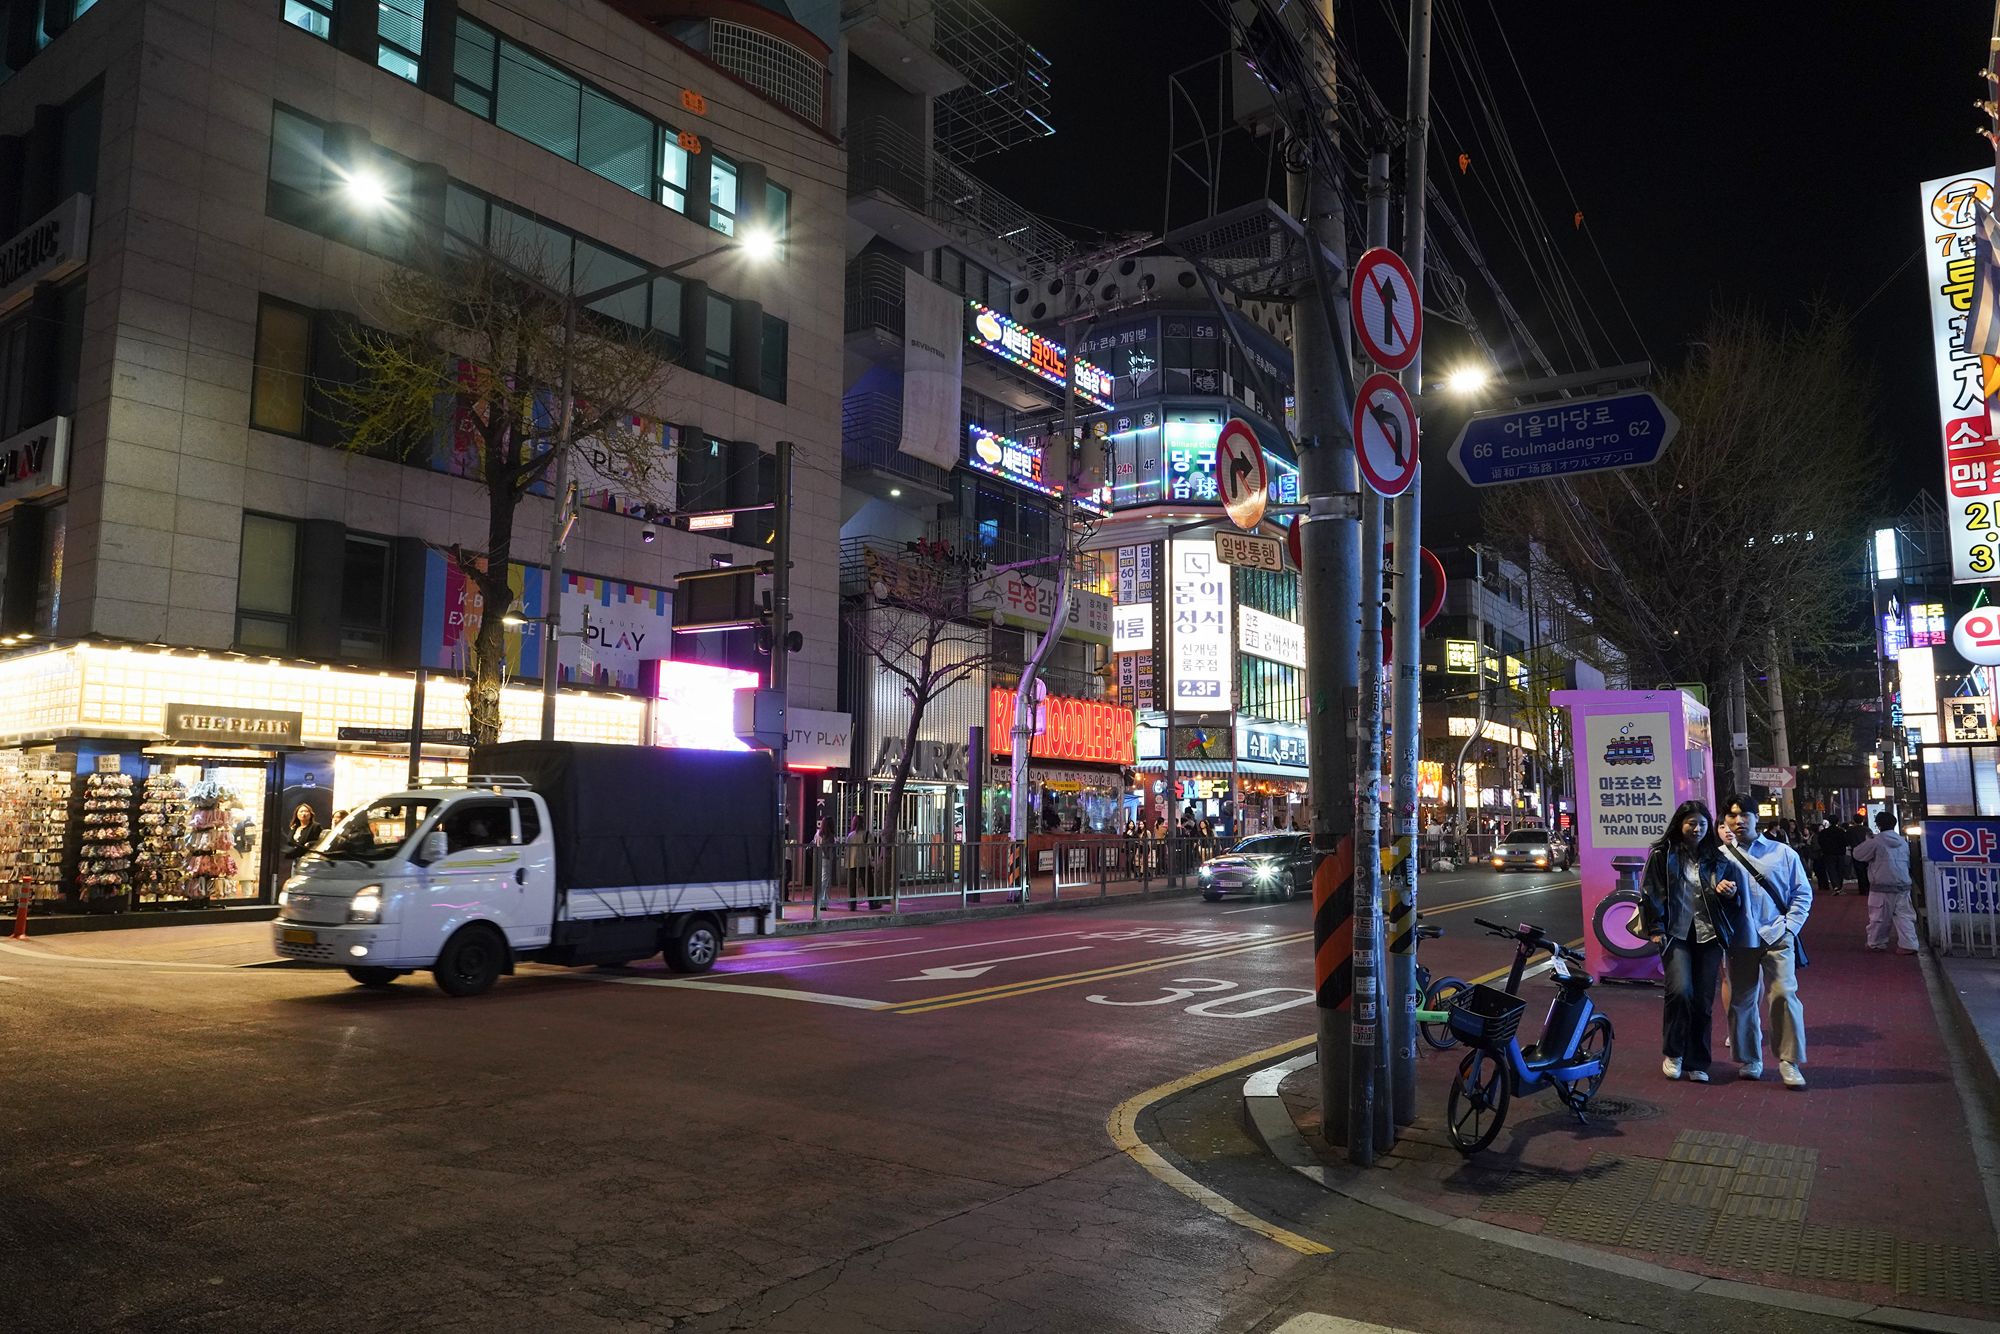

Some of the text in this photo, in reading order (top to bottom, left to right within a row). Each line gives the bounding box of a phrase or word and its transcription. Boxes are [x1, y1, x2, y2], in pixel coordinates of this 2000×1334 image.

[1504, 406, 1614, 438] 어울마당로
[1628, 420, 1650, 438] 62
[1473, 443, 1493, 459] 66
[1502, 433, 1619, 459] Eoulmadang-ro
[1143, 459, 1155, 470] 4F
[1171, 450, 1216, 472] 당구
[1173, 477, 1217, 500] 台球
[1221, 537, 1275, 566] 일방통행
[1121, 568, 1134, 578] 60
[590, 617, 646, 630] EAUTY
[588, 626, 645, 651] PLAY
[1182, 644, 1217, 656] 신개념
[1182, 659, 1218, 672] 룸주점
[181, 714, 292, 734] THE PLAIN
[817, 732, 847, 747] PLAY
[1104, 706, 1134, 762] BAR
[1599, 775, 1662, 790] 마포순환
[1599, 792, 1663, 807] 열차버스
[1599, 813, 1667, 824] MAPO TOUR
[1603, 825, 1665, 835] TRAIN BUS
[1086, 977, 1317, 1019] 30
